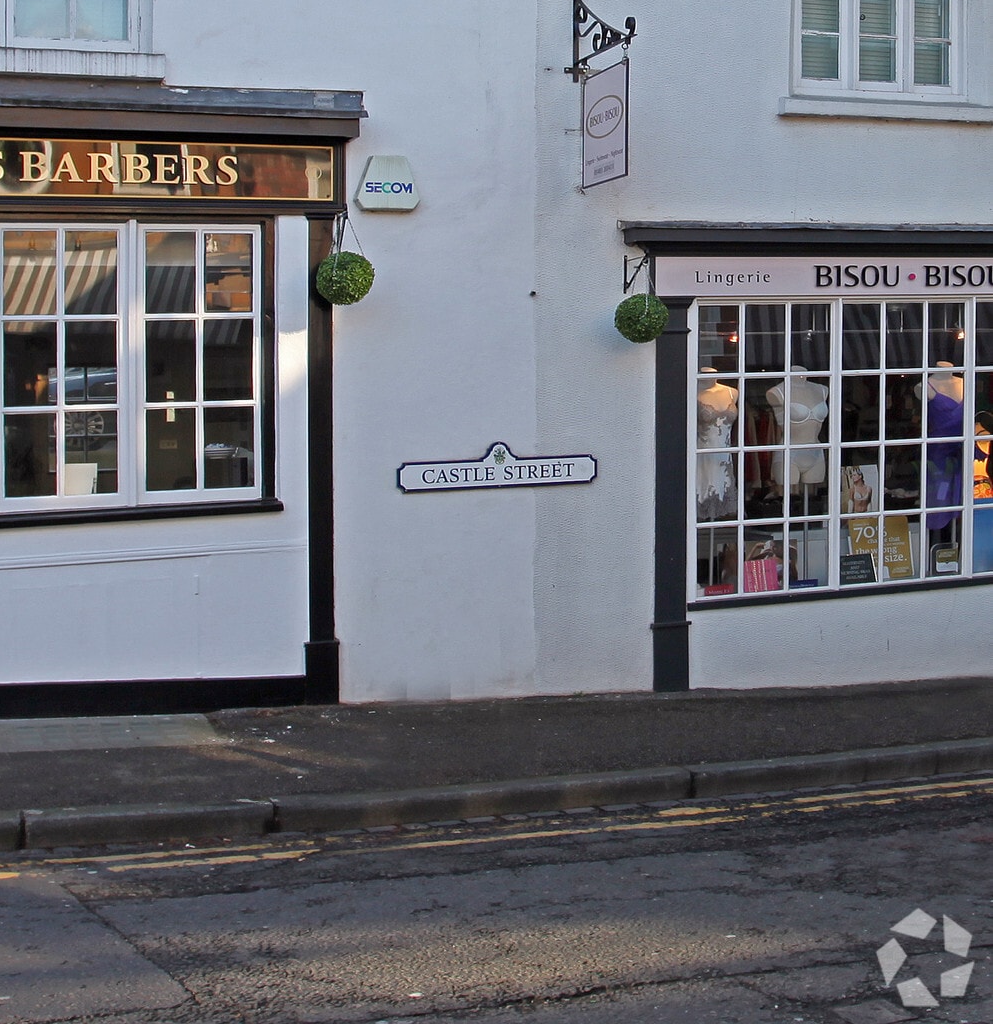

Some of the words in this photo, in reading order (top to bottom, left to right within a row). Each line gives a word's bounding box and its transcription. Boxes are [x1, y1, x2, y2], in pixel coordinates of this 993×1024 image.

[19, 150, 238, 186] BARBERS
[366, 182, 412, 193] SECOM
[694, 270, 771, 286] Lingerie
[814, 264, 900, 288] BISOU
[422, 466, 495, 484] CASTLE
[503, 462, 575, 481] STREET
